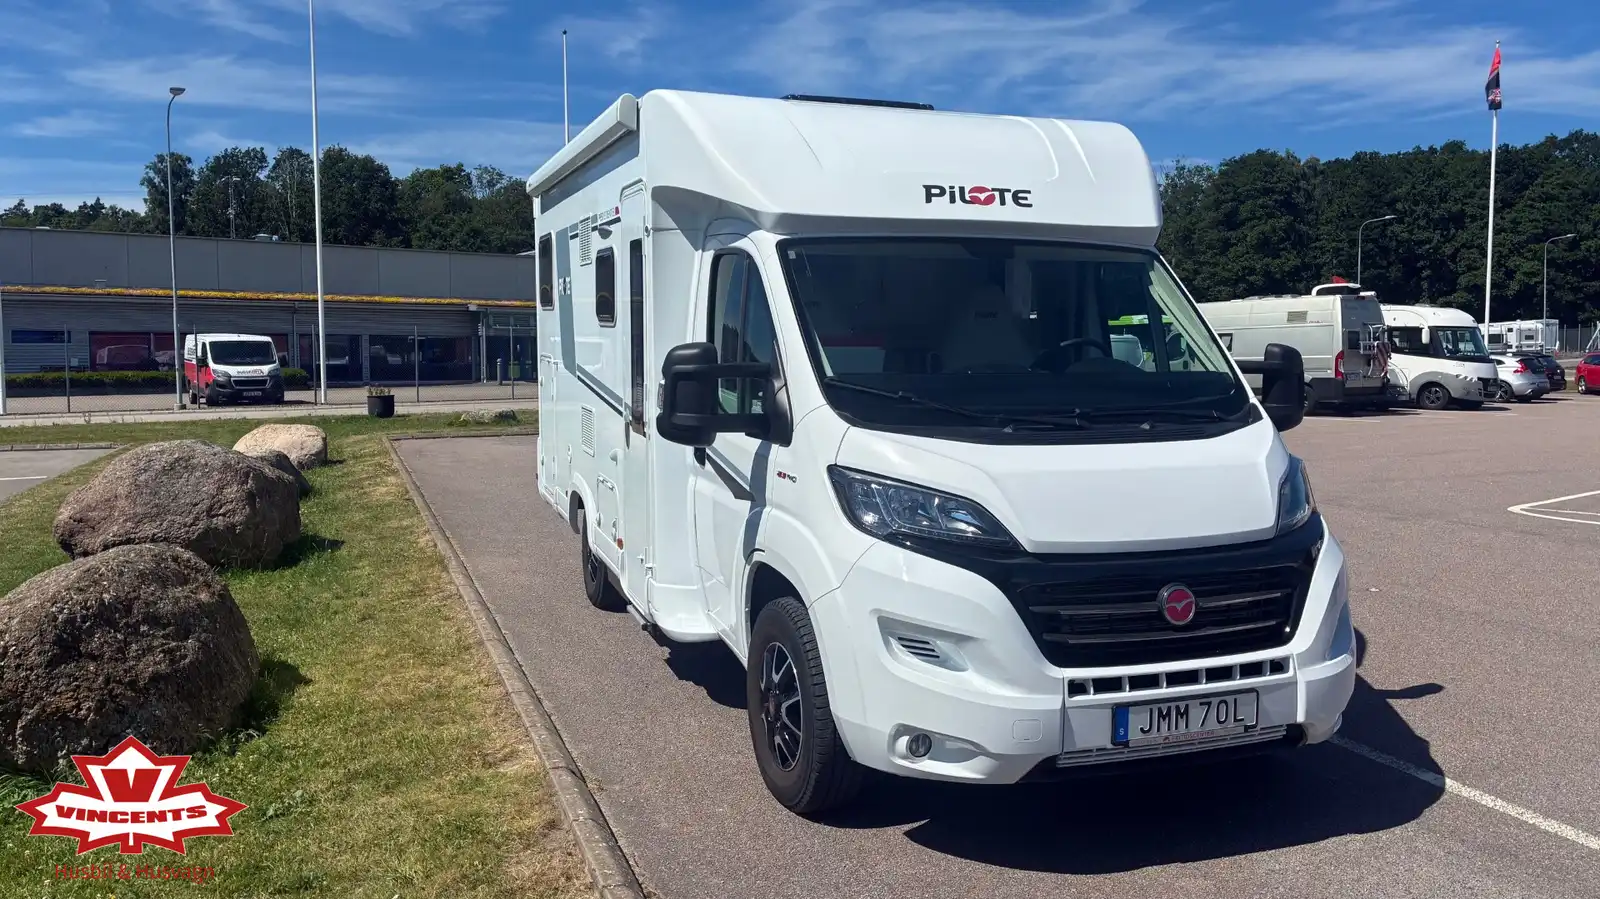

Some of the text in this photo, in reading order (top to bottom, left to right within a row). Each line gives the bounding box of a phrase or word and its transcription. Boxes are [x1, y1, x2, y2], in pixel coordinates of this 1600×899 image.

[1138, 698, 1245, 735] JMM 70L
[1119, 727, 1125, 736] S
